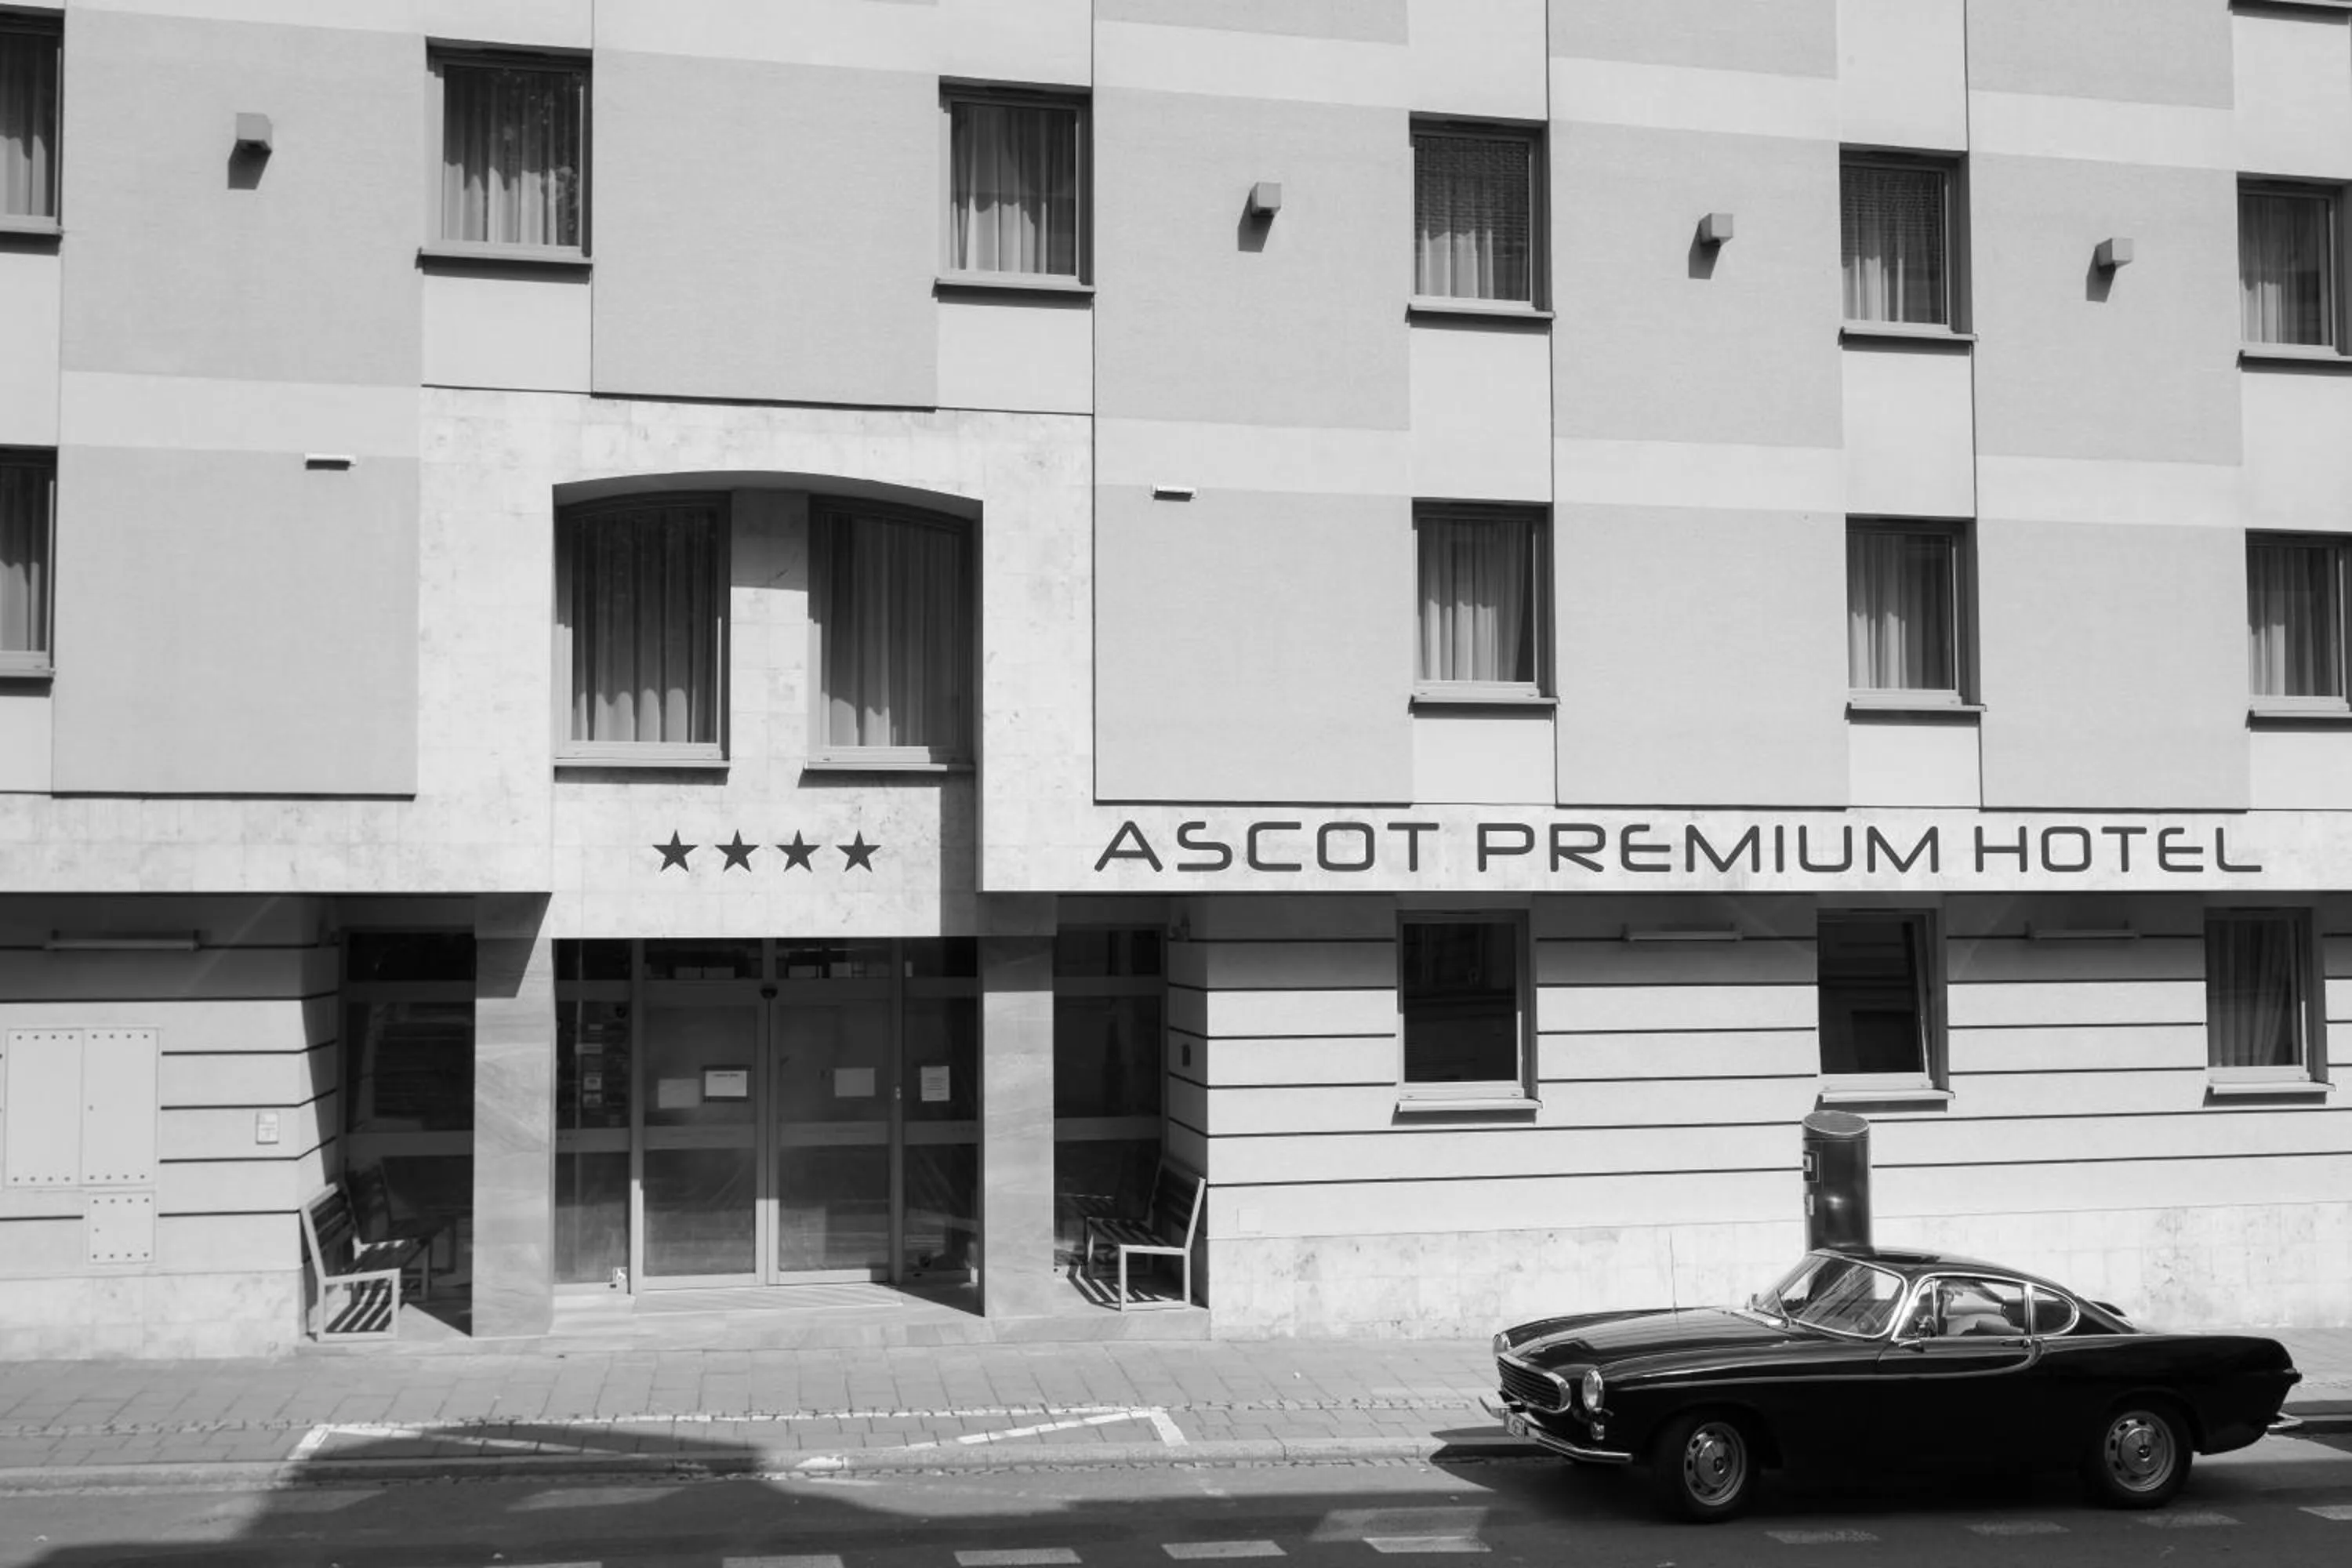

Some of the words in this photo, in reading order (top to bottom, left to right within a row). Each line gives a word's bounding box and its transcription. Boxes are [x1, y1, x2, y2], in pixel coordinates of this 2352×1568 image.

[1094, 822, 1439, 873] ASCOT
[1478, 823, 1939, 873] PREMIUM
[1975, 826, 2262, 873] HOTEL
